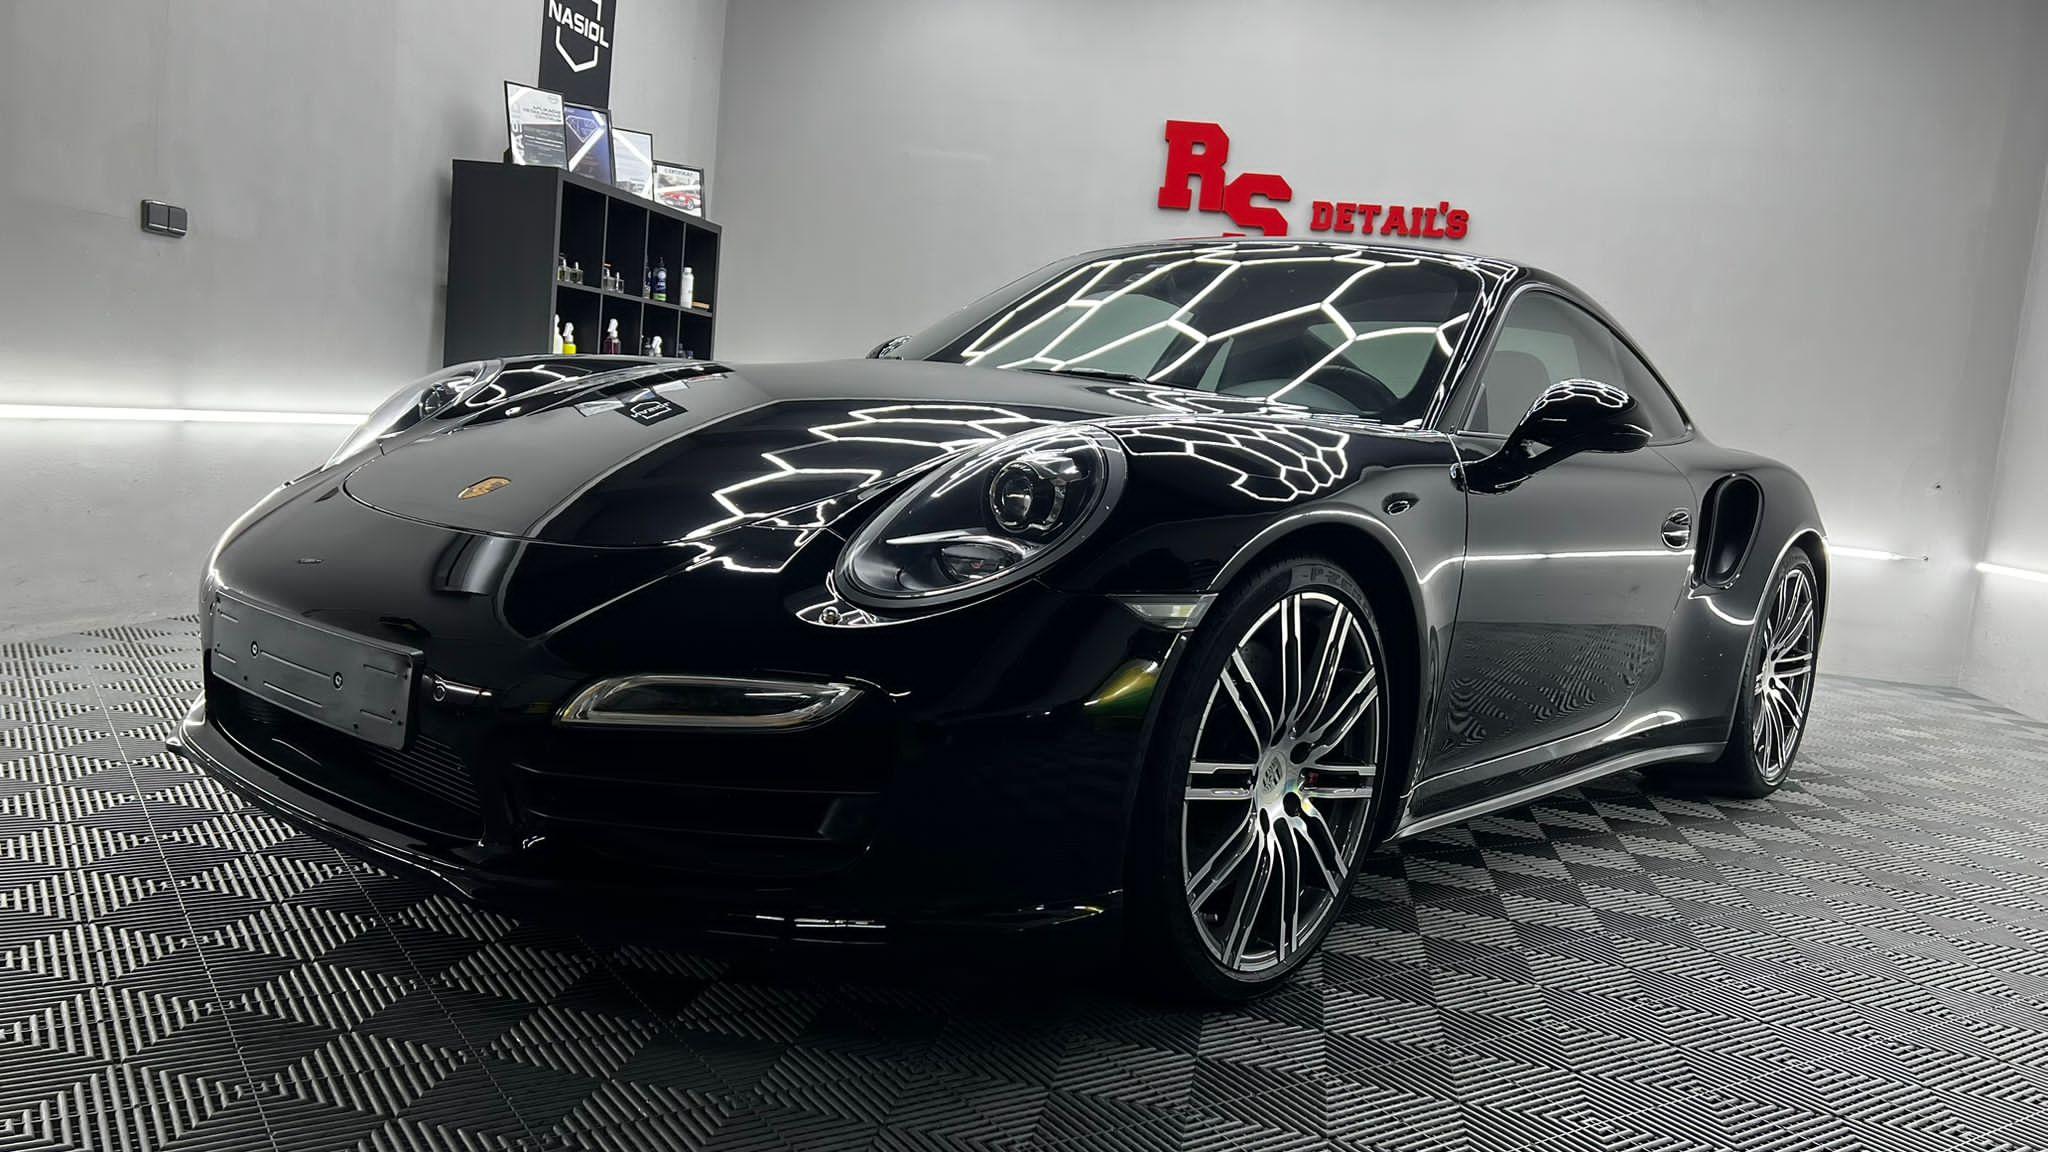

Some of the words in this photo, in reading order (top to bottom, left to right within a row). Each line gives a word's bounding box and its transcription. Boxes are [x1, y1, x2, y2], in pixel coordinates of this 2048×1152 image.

[549, 0, 609, 48] NASIOL
[1158, 120, 1292, 236] RS
[1310, 201, 1469, 239] DETAIL'S
